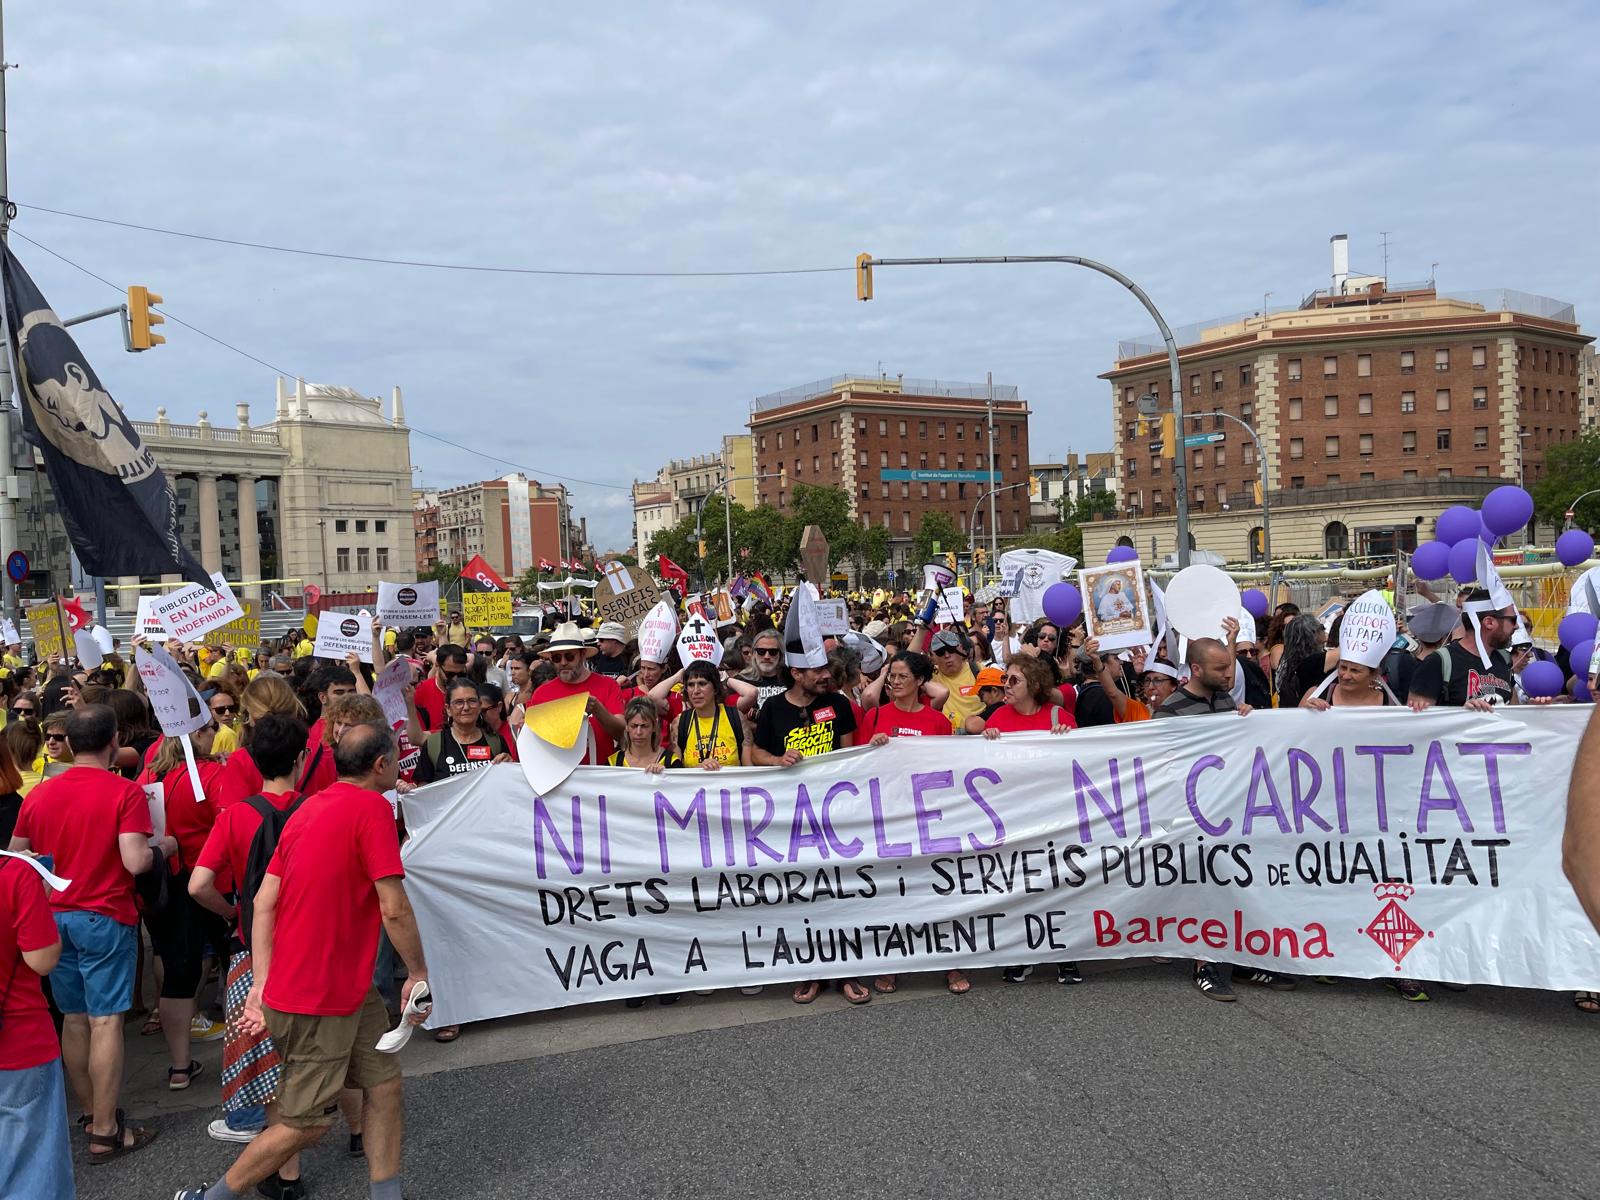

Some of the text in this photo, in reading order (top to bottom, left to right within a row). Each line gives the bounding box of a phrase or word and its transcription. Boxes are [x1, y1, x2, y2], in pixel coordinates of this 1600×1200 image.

[476, 572, 500, 592] CGT
[159, 580, 222, 614] BIBLIOTEQUS
[169, 609, 189, 624] EN
[188, 592, 227, 614] VAGA
[602, 586, 654, 616] SERVEIS
[608, 597, 659, 623] SOCIALS
[175, 604, 235, 637] INDEFINIDA
[1343, 614, 1390, 630] PECADOR
[681, 634, 716, 645] COLLBONI
[688, 642, 715, 652] AL PAPA
[1342, 627, 1384, 644] AL PAPA
[1346, 639, 1369, 653] VAS
[533, 740, 1532, 881] NI MIRACLES NI CARITAT
[538, 877, 671, 926] DRETS
[691, 864, 878, 913] LABORALS
[1267, 863, 1291, 886] DE
[546, 938, 655, 991] VAGA
[684, 937, 708, 974] A
[1024, 910, 1068, 950] DE
[1094, 909, 1334, 959] Barcelona
